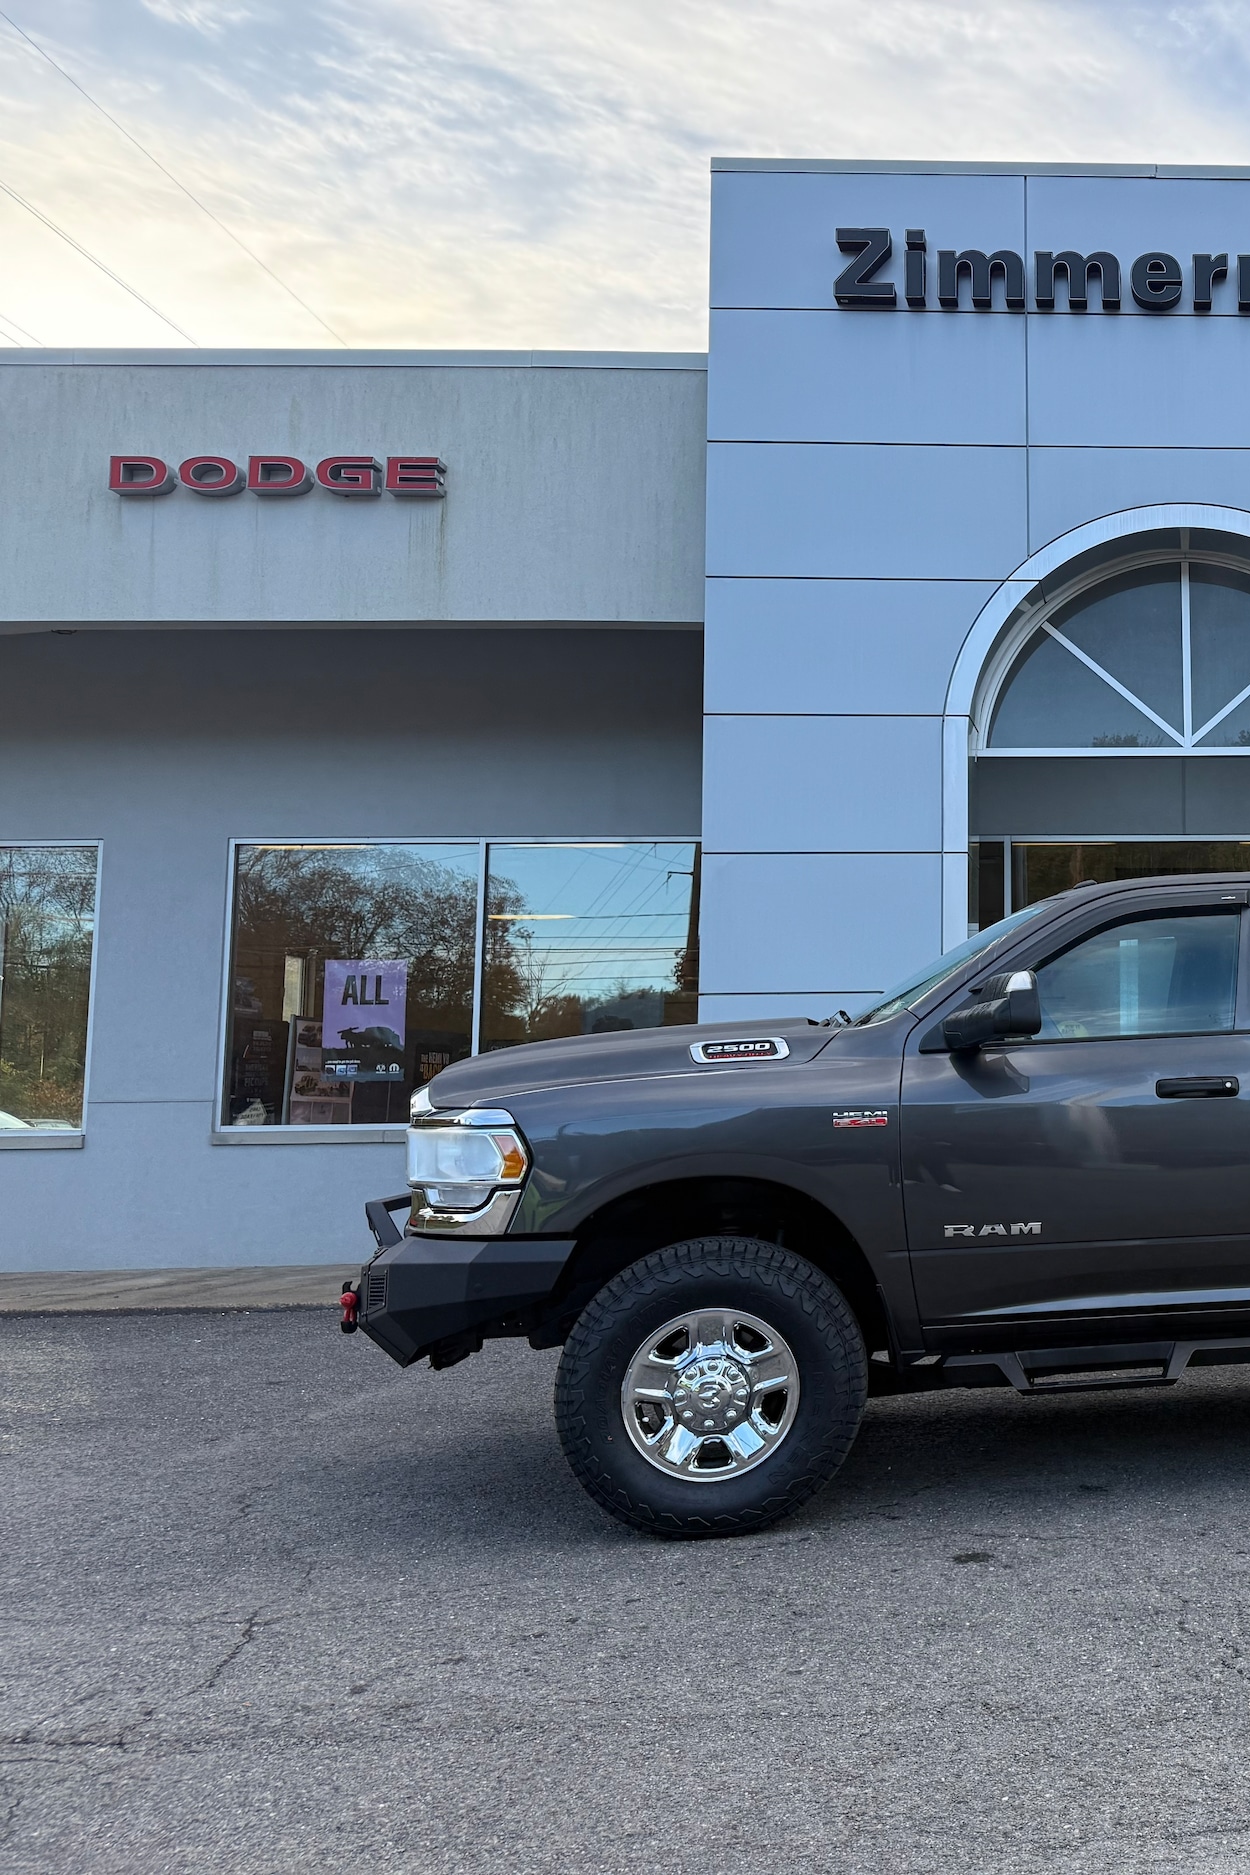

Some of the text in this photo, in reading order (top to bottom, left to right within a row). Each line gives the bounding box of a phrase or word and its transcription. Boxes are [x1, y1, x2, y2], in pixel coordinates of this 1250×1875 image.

[109, 455, 447, 498] DODGE
[341, 974, 390, 1006] ALL
[706, 1042, 771, 1054] 2500
[832, 1110, 888, 1118] HEMI
[943, 1222, 1042, 1238] RAM
